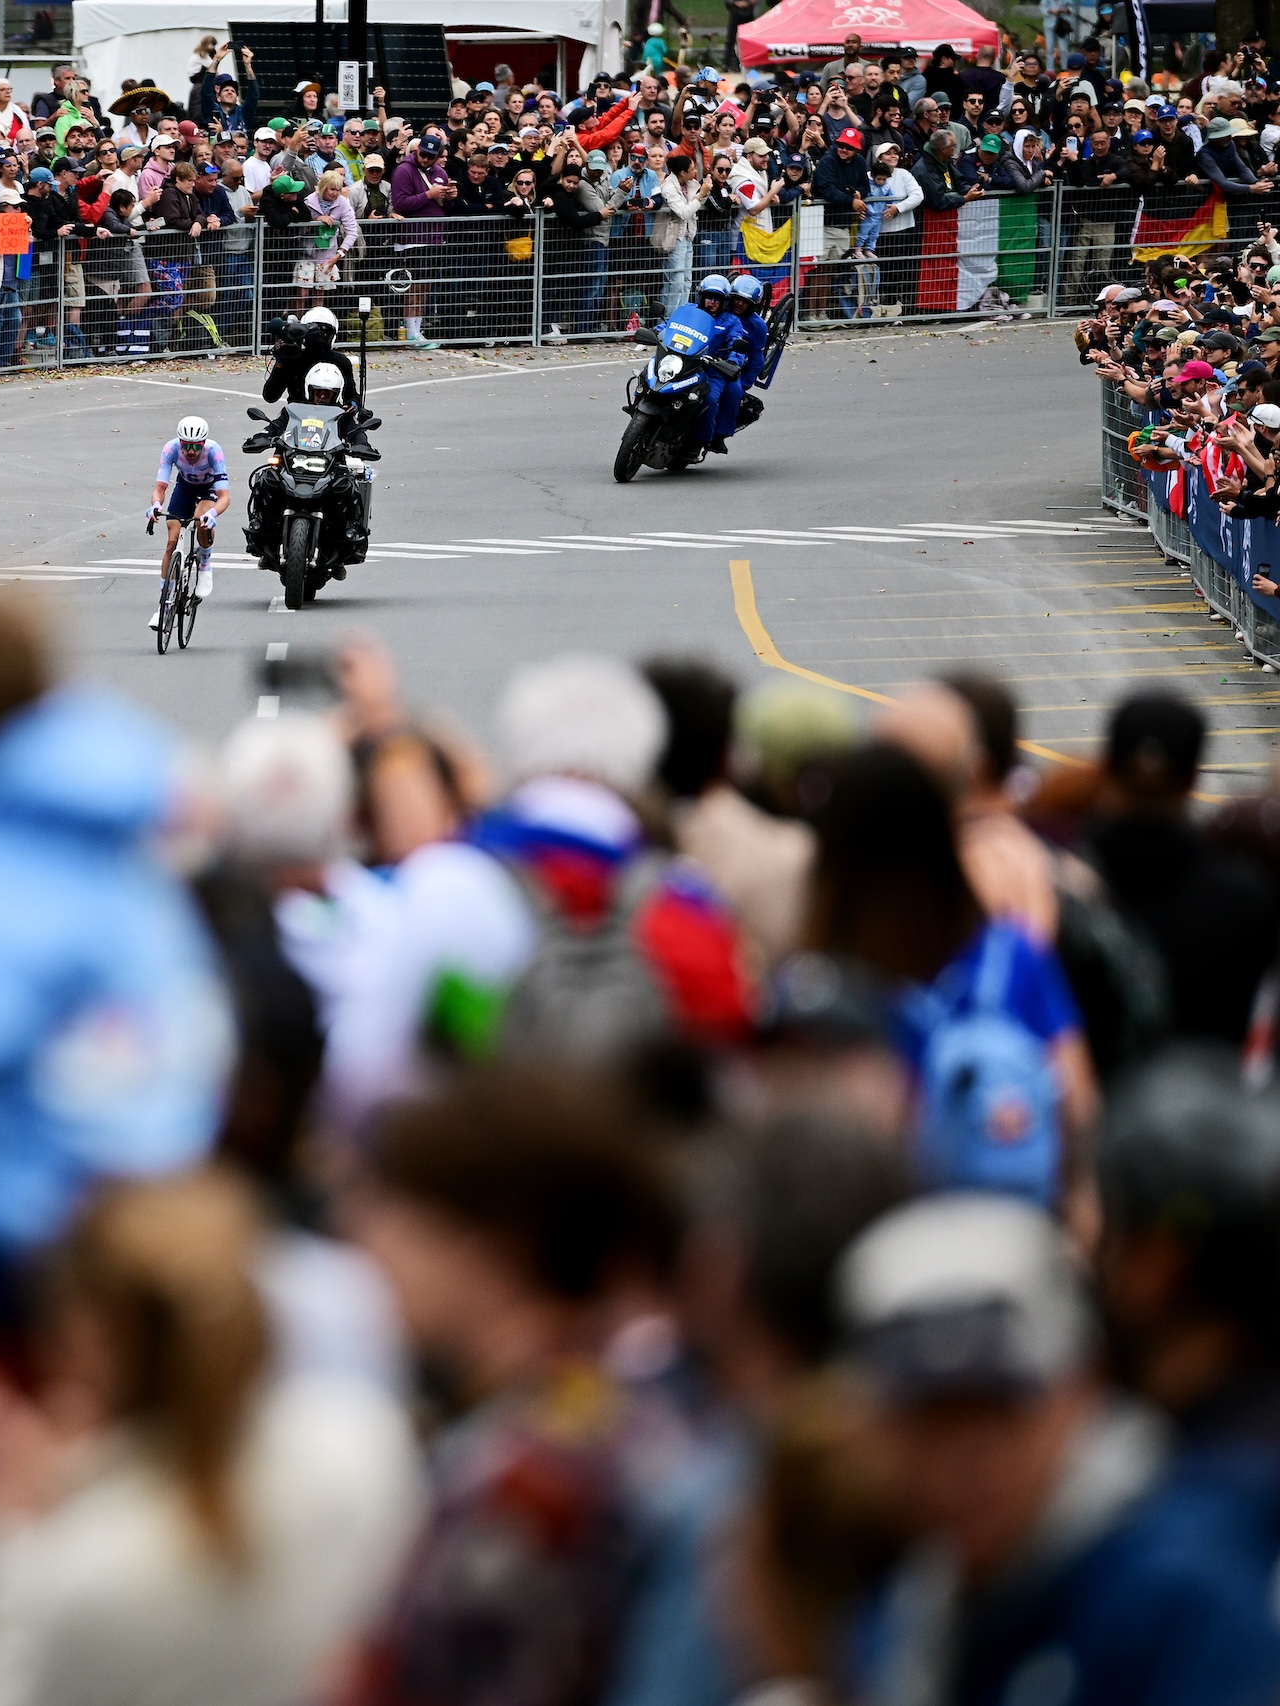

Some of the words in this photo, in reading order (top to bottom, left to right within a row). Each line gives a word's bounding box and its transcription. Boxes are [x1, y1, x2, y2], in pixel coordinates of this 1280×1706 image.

[1, 215, 19, 226] GO
[1, 238, 19, 249] GO
[669, 321, 709, 343] SHIMANO
[672, 376, 699, 390] SHIMANO
